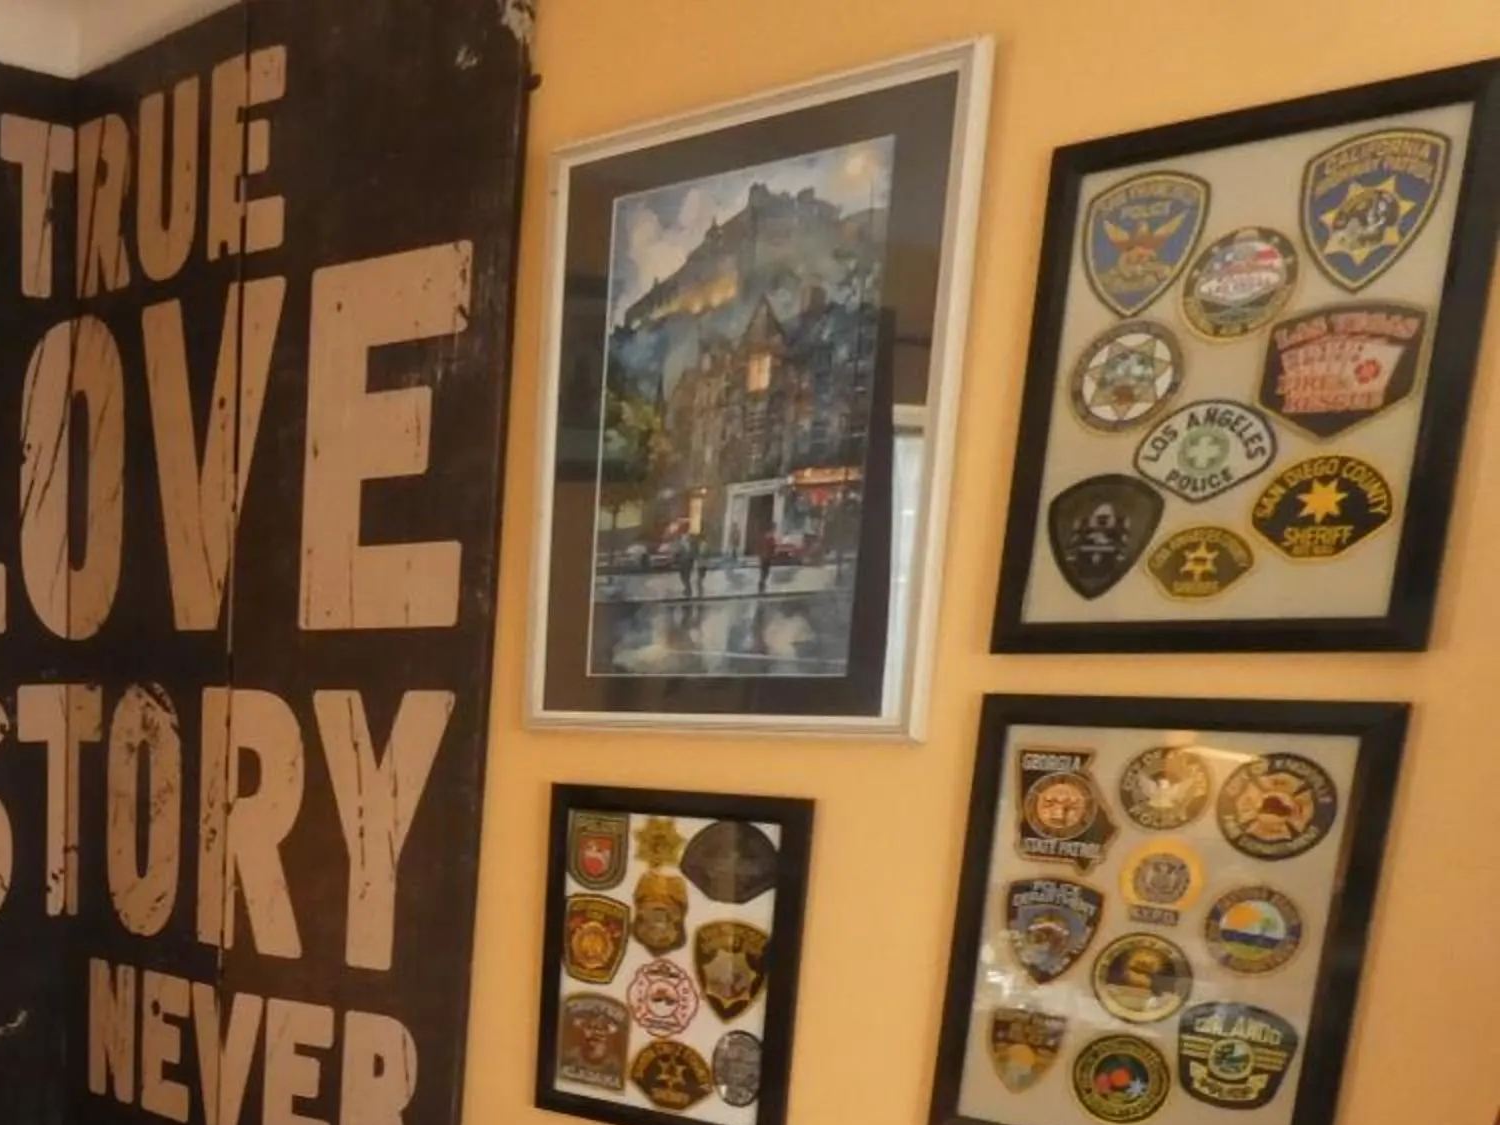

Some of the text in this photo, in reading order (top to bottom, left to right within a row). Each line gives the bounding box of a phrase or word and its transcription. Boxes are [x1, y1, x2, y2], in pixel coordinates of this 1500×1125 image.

[0, 44, 287, 299] TRUE
[1142, 406, 1266, 463] LOS ANGELES
[1165, 467, 1233, 492] POLICE
[1254, 457, 1388, 519] SAN DIEGO COUNTY
[1022, 753, 1080, 772] GEORGIA
[1194, 1014, 1282, 1046] ORLANDO
